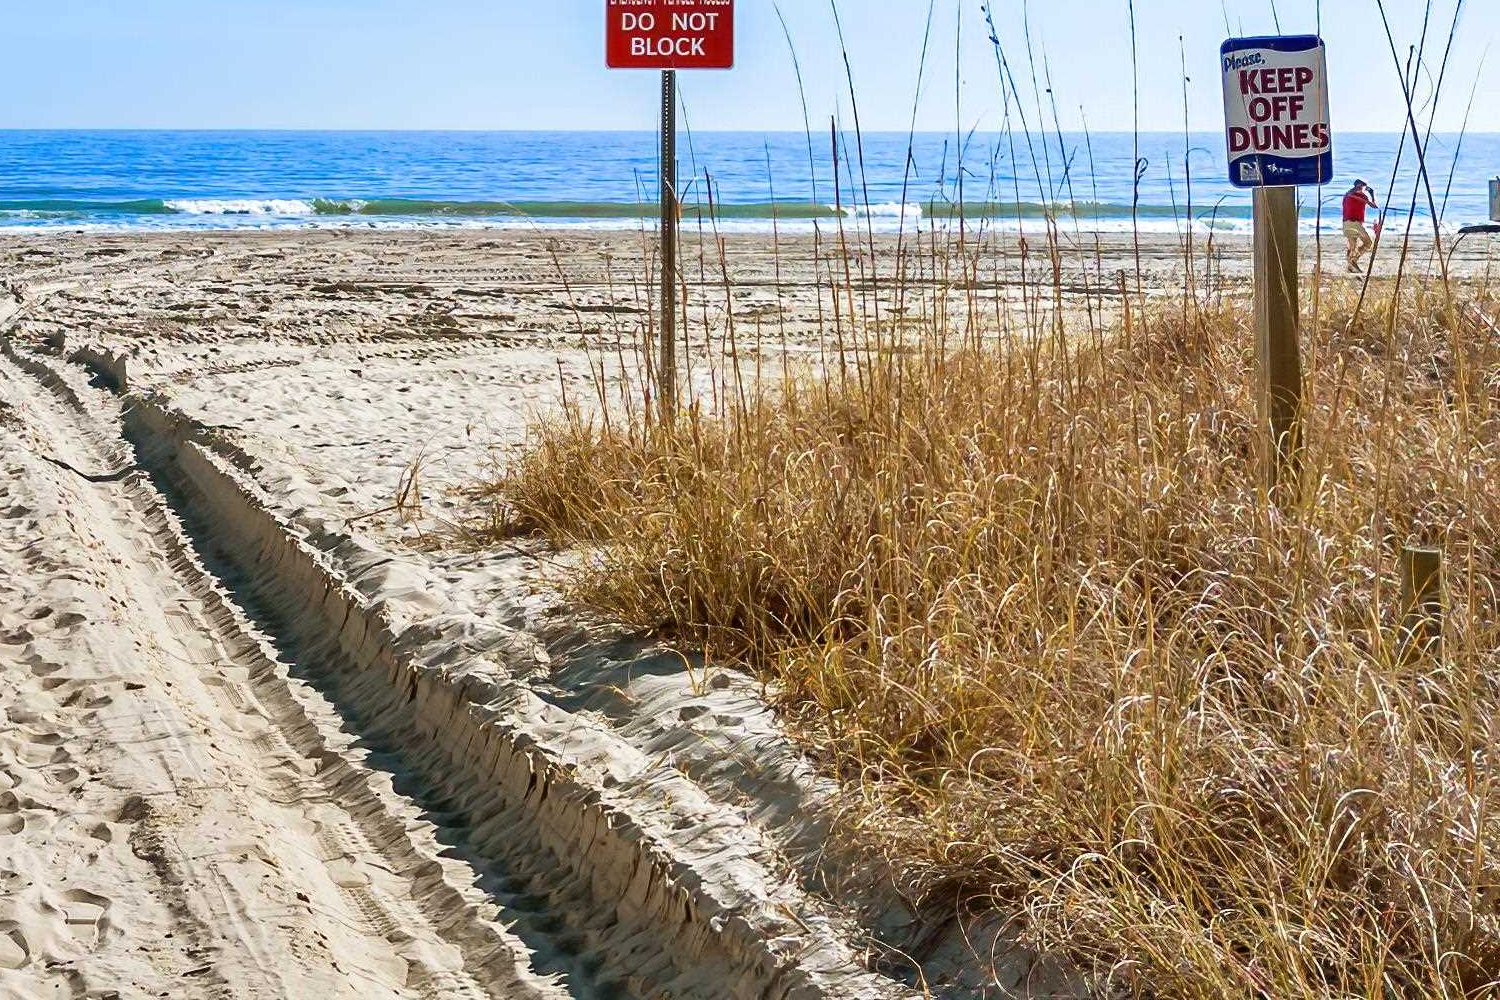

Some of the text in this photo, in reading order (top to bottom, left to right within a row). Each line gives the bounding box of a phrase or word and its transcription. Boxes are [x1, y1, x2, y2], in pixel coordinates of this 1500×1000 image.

[621, 12, 719, 31] DO NOT
[631, 37, 706, 56] BLOCK
[1238, 66, 1314, 95] KEEP
[1248, 95, 1305, 122] OFF
[1228, 123, 1330, 152] DUNES
